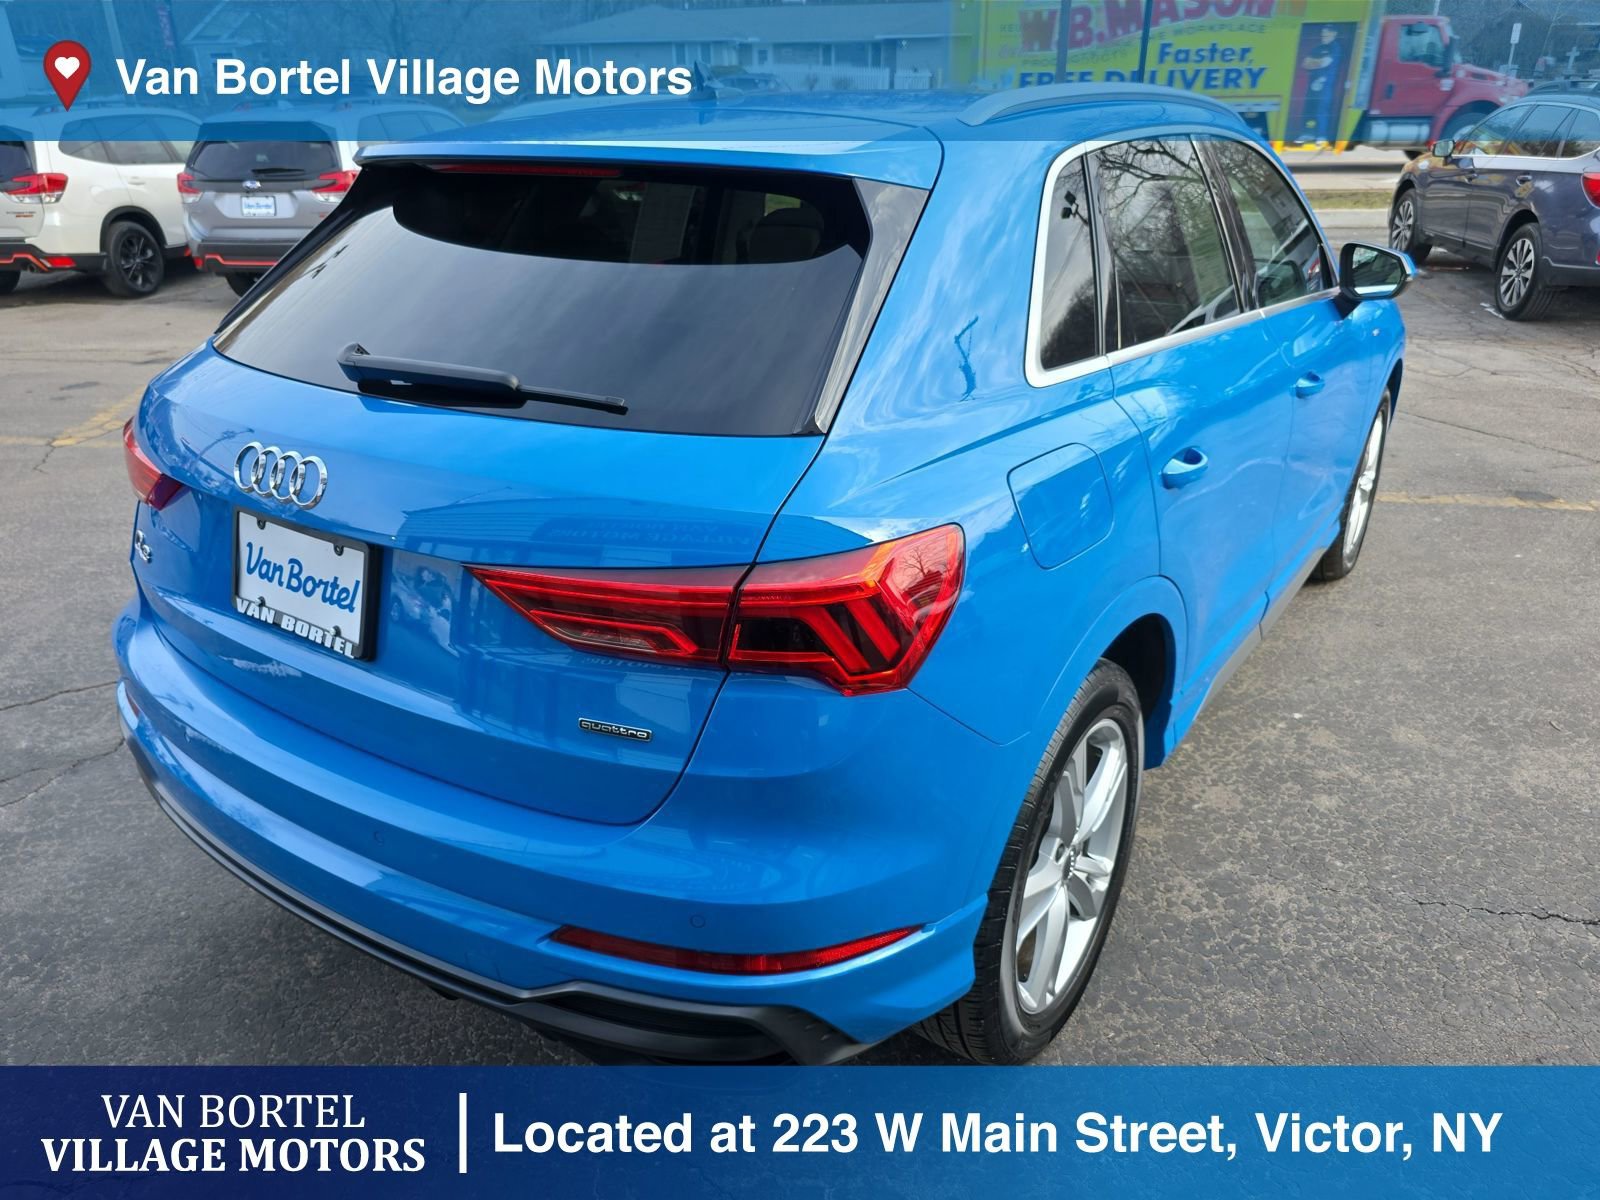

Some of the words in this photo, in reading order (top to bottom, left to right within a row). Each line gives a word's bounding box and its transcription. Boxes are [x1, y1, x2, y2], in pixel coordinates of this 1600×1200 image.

[1158, 42, 1254, 64] Faster,
[235, 596, 276, 625] VAN
[280, 616, 355, 660] BORTEL
[581, 720, 648, 739] quattro
